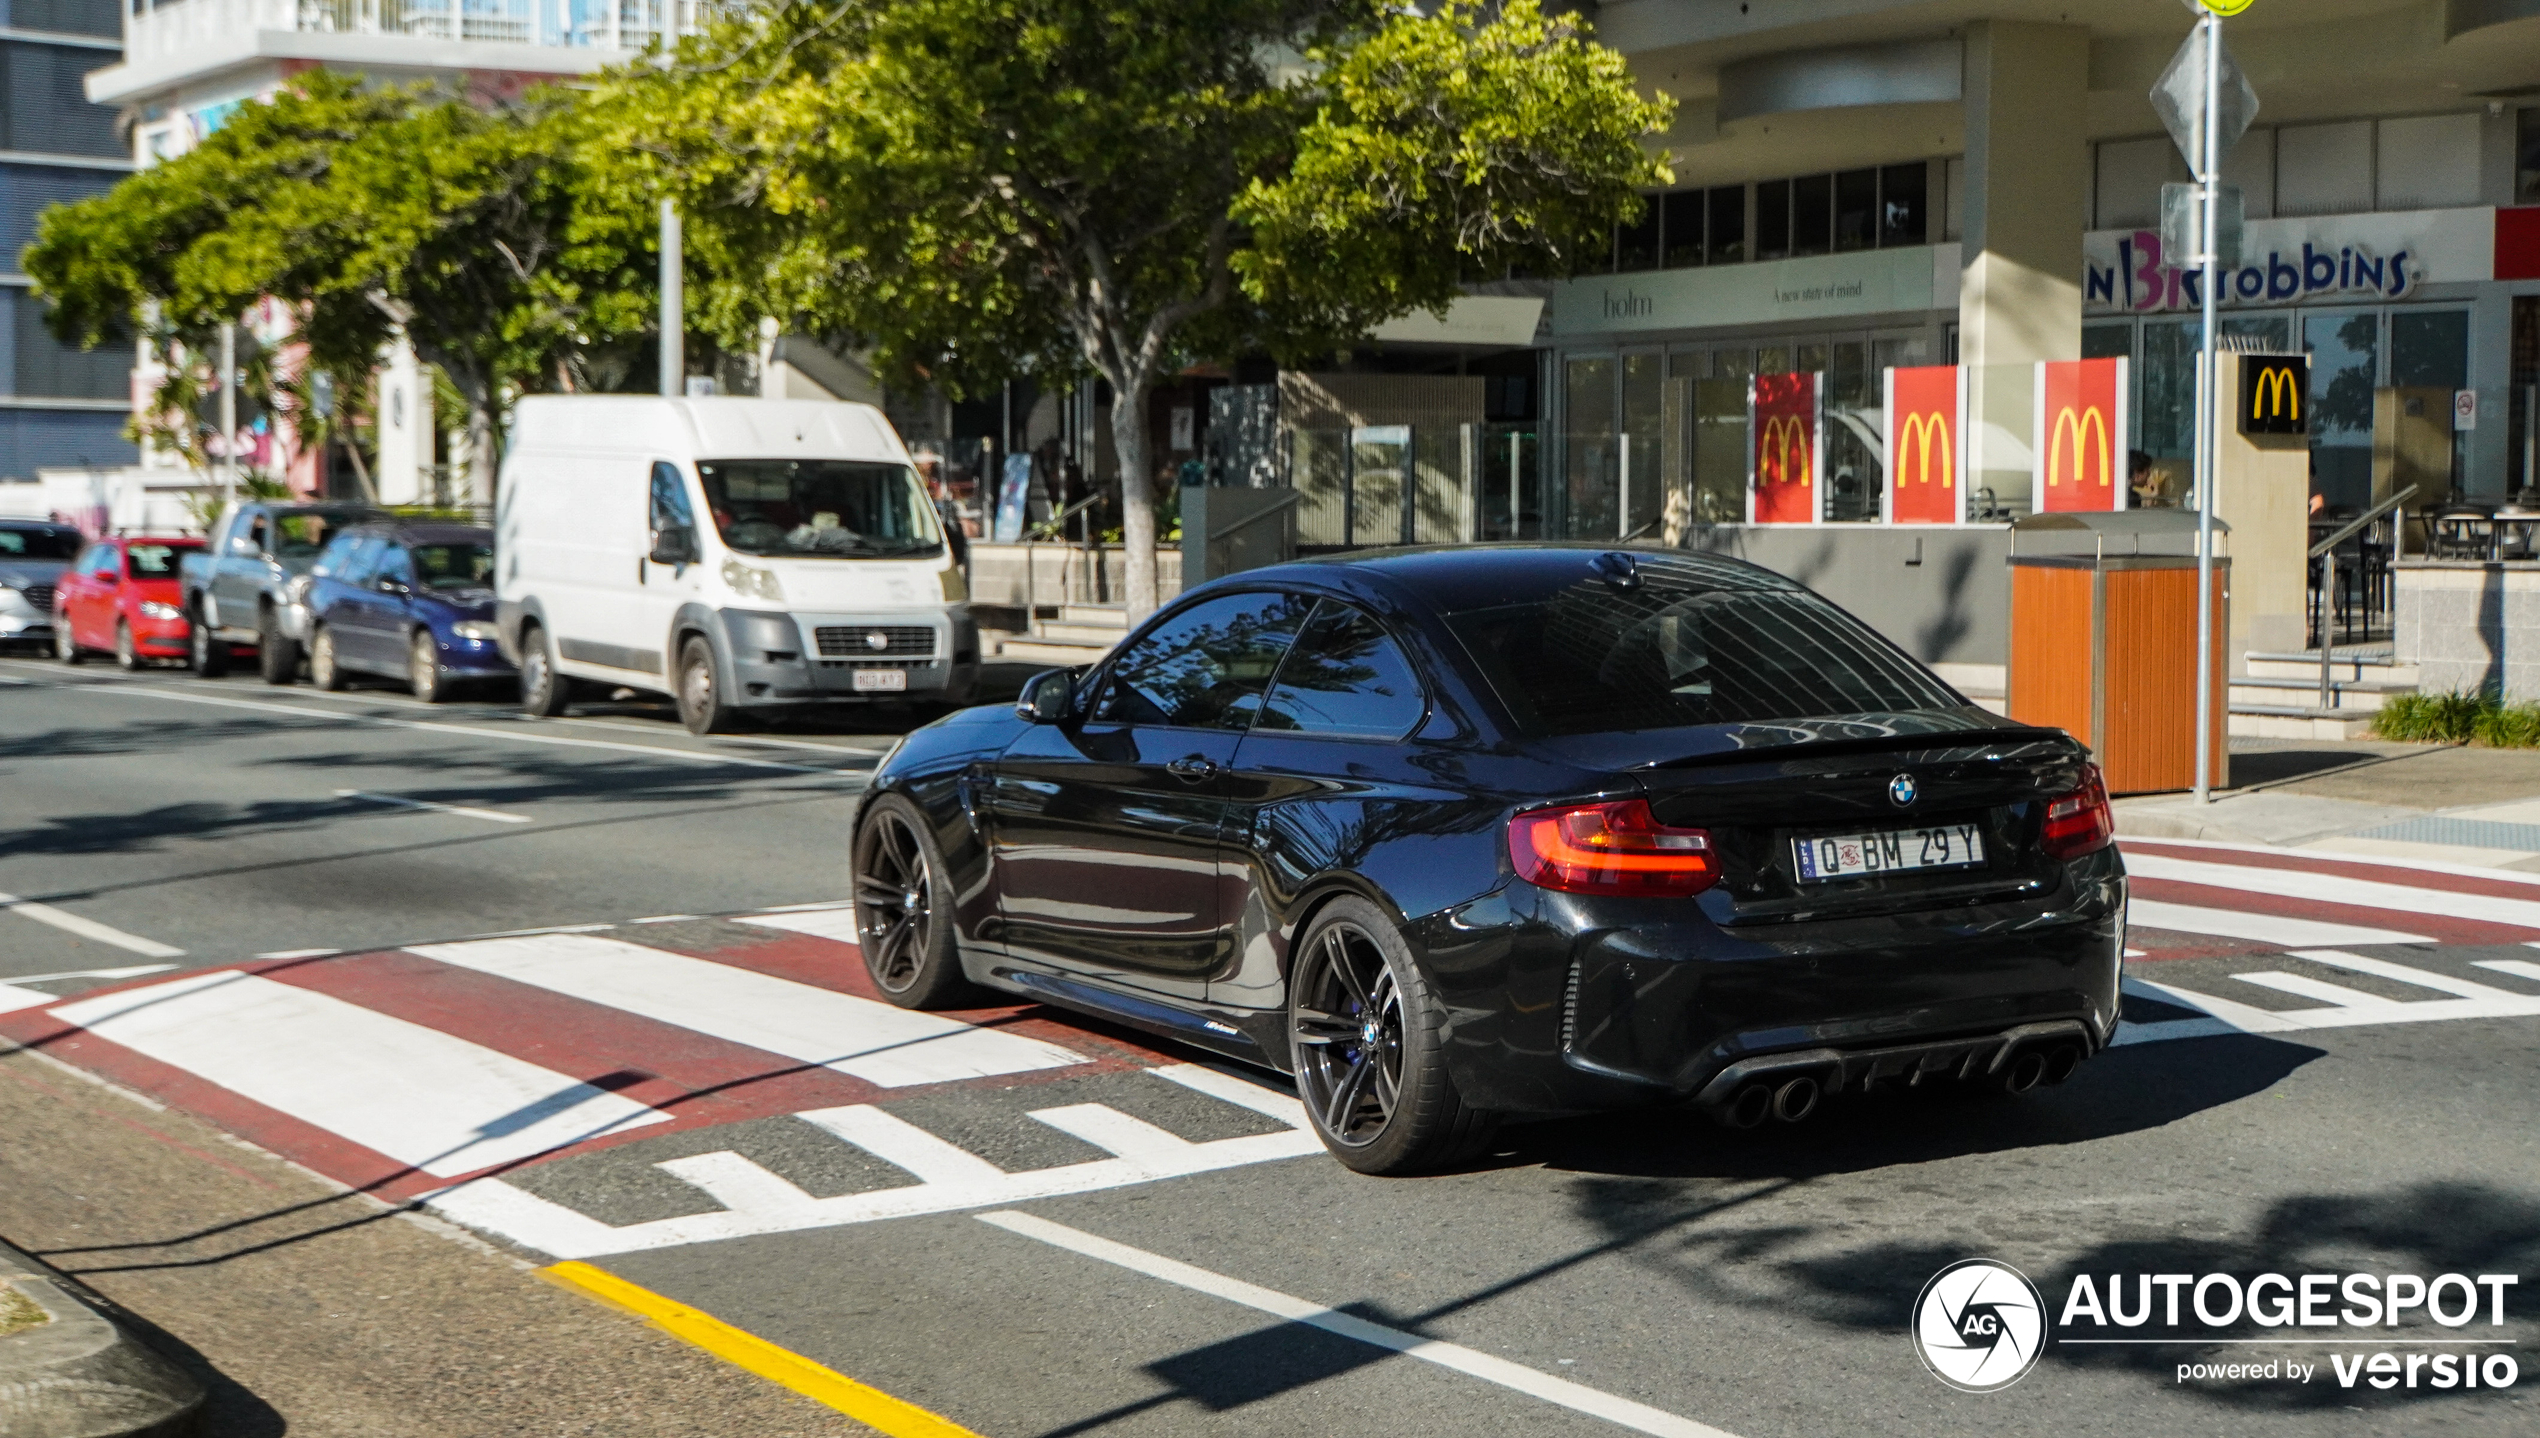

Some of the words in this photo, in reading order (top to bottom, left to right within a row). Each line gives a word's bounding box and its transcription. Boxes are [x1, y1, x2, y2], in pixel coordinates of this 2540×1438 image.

[1824, 283, 1835, 298] of
[1836, 279, 1862, 298] mind
[1604, 289, 1652, 319] holm
